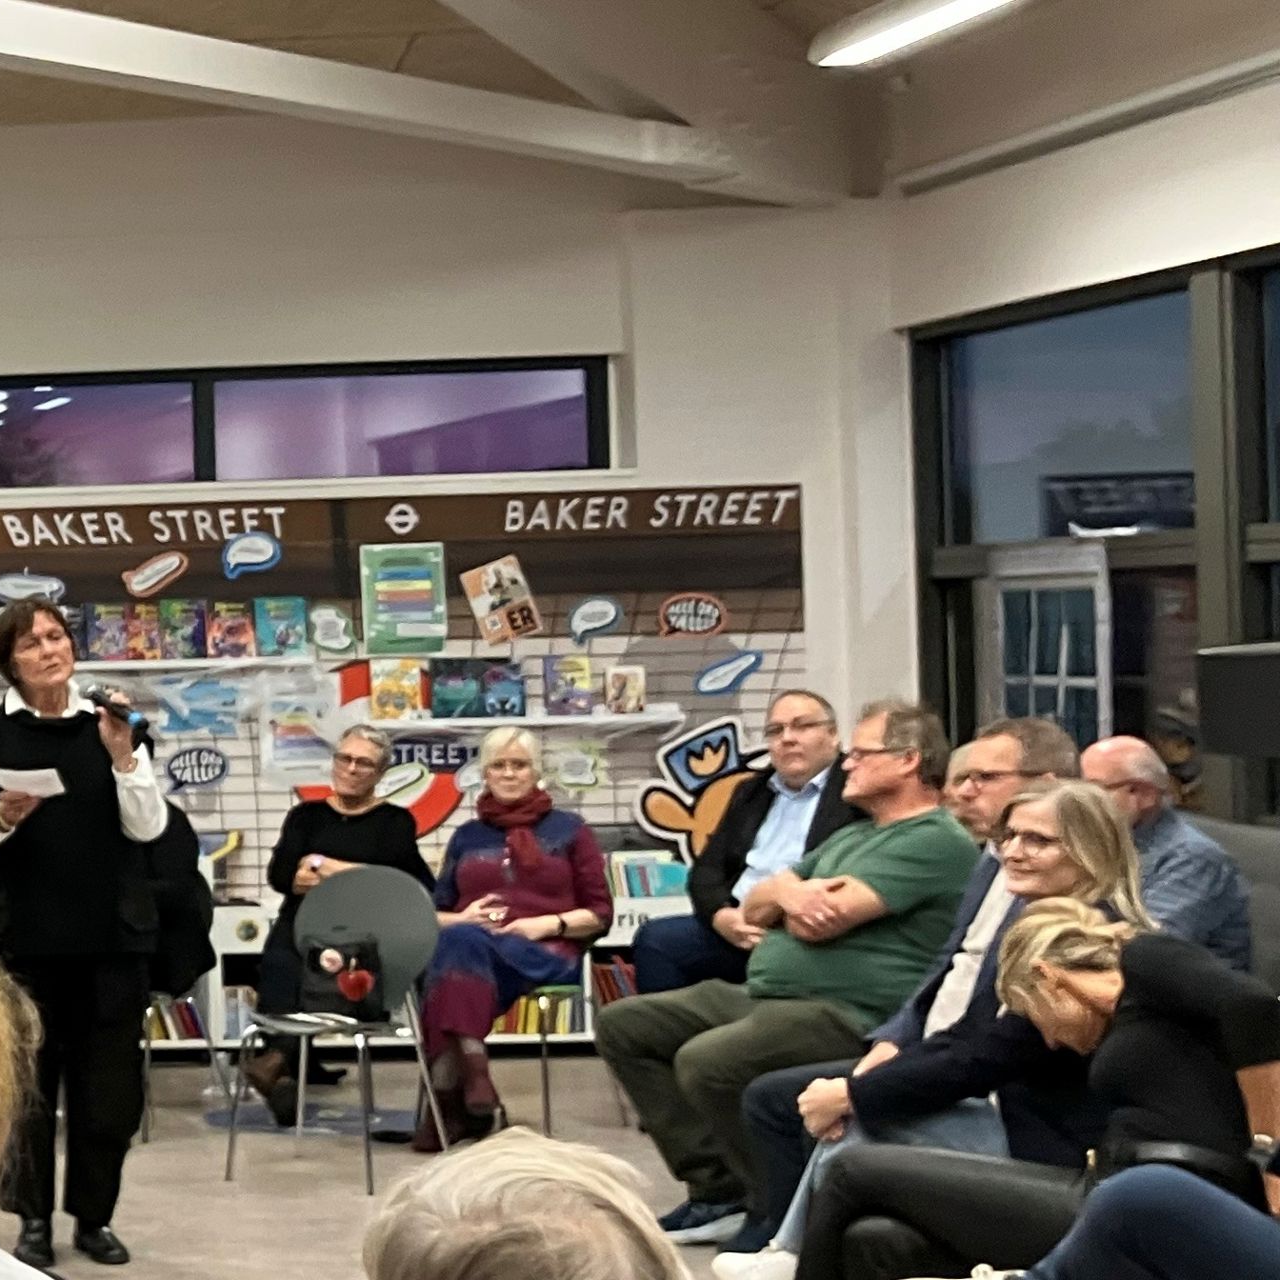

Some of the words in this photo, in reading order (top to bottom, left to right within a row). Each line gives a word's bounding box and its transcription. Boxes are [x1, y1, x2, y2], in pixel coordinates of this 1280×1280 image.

[2, 511, 133, 547] BAKER
[149, 507, 286, 543] STREET
[504, 495, 629, 532] BAKER
[649, 489, 799, 528] STREET
[389, 742, 477, 765] TREE
